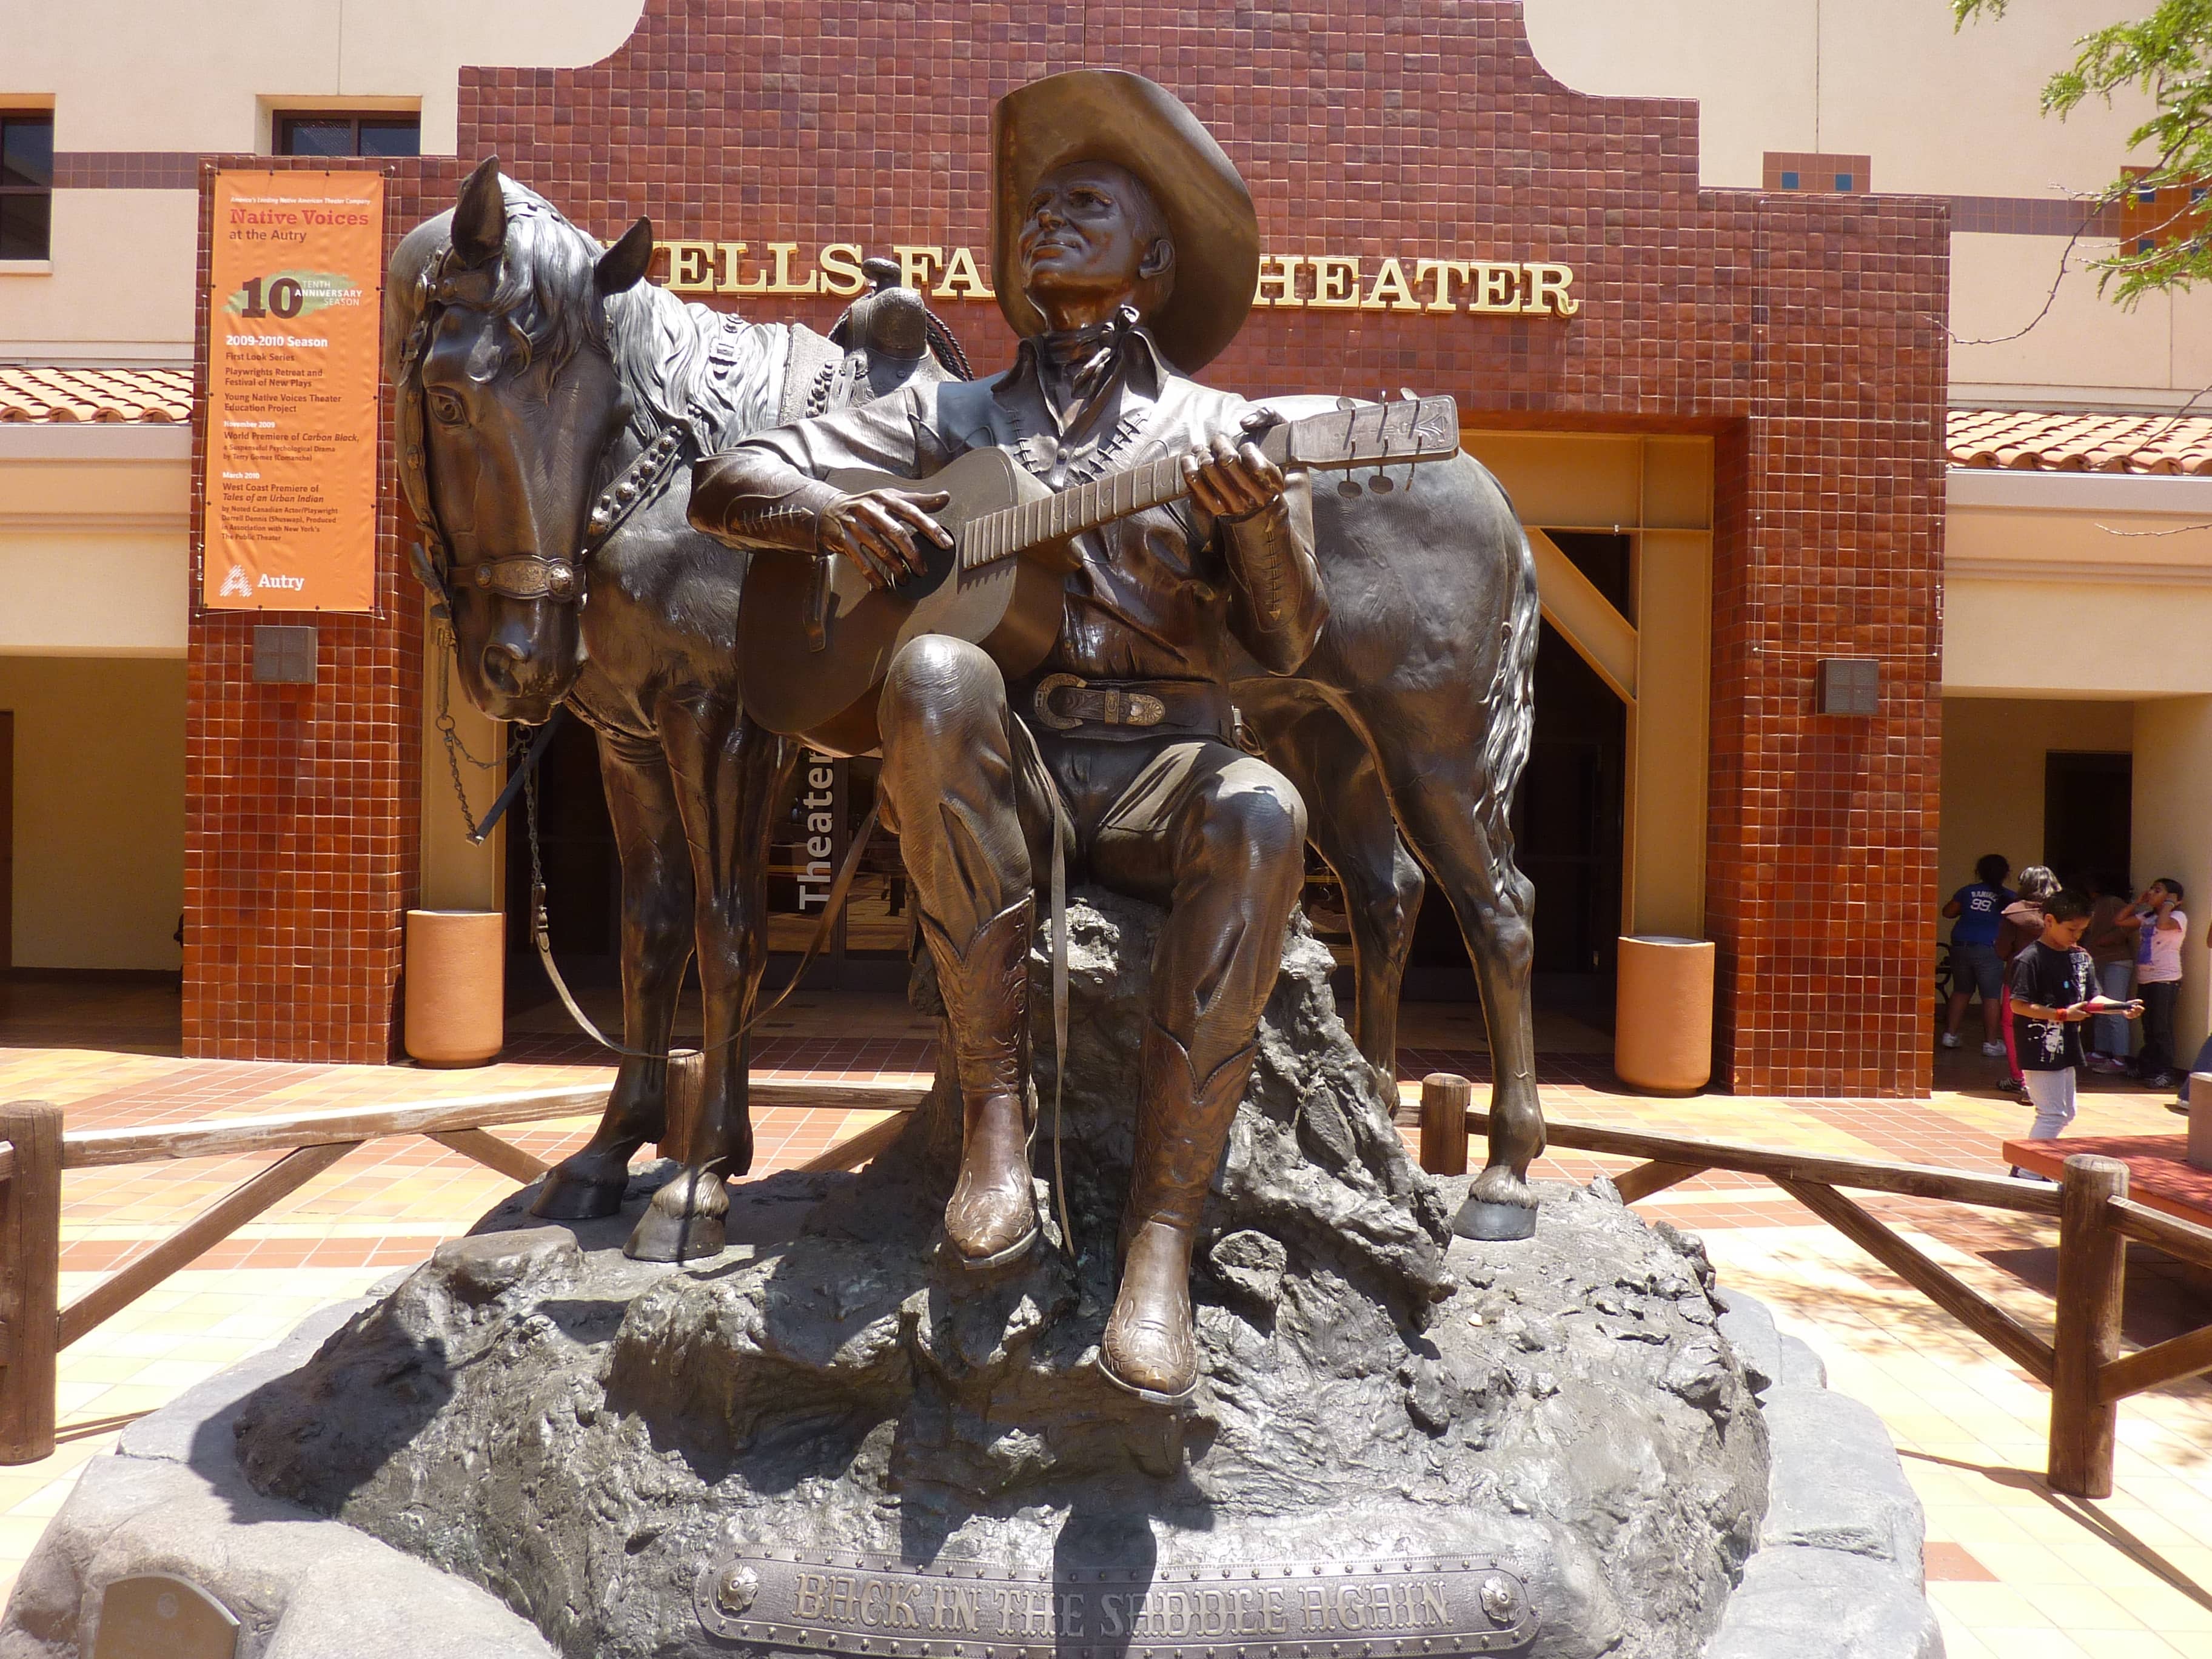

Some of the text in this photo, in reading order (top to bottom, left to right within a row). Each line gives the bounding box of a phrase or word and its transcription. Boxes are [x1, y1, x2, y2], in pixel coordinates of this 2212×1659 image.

[230, 209, 369, 225] Native Voices
[229, 229, 307, 243] at the Autry
[653, 241, 868, 297] ELLS
[1252, 256, 1579, 318] HEATER
[242, 276, 303, 319] 10
[226, 335, 328, 347] 2009-2010 Season
[225, 367, 273, 377] Playwrights
[290, 380, 312, 388] Plays
[224, 393, 249, 403] Young
[224, 403, 297, 413] Education Project
[246, 493, 255, 503] of
[258, 574, 304, 591] Autry
[797, 751, 833, 910] Theater
[793, 1572, 1454, 1638] BACK IN THE SADDLE AGAIN
